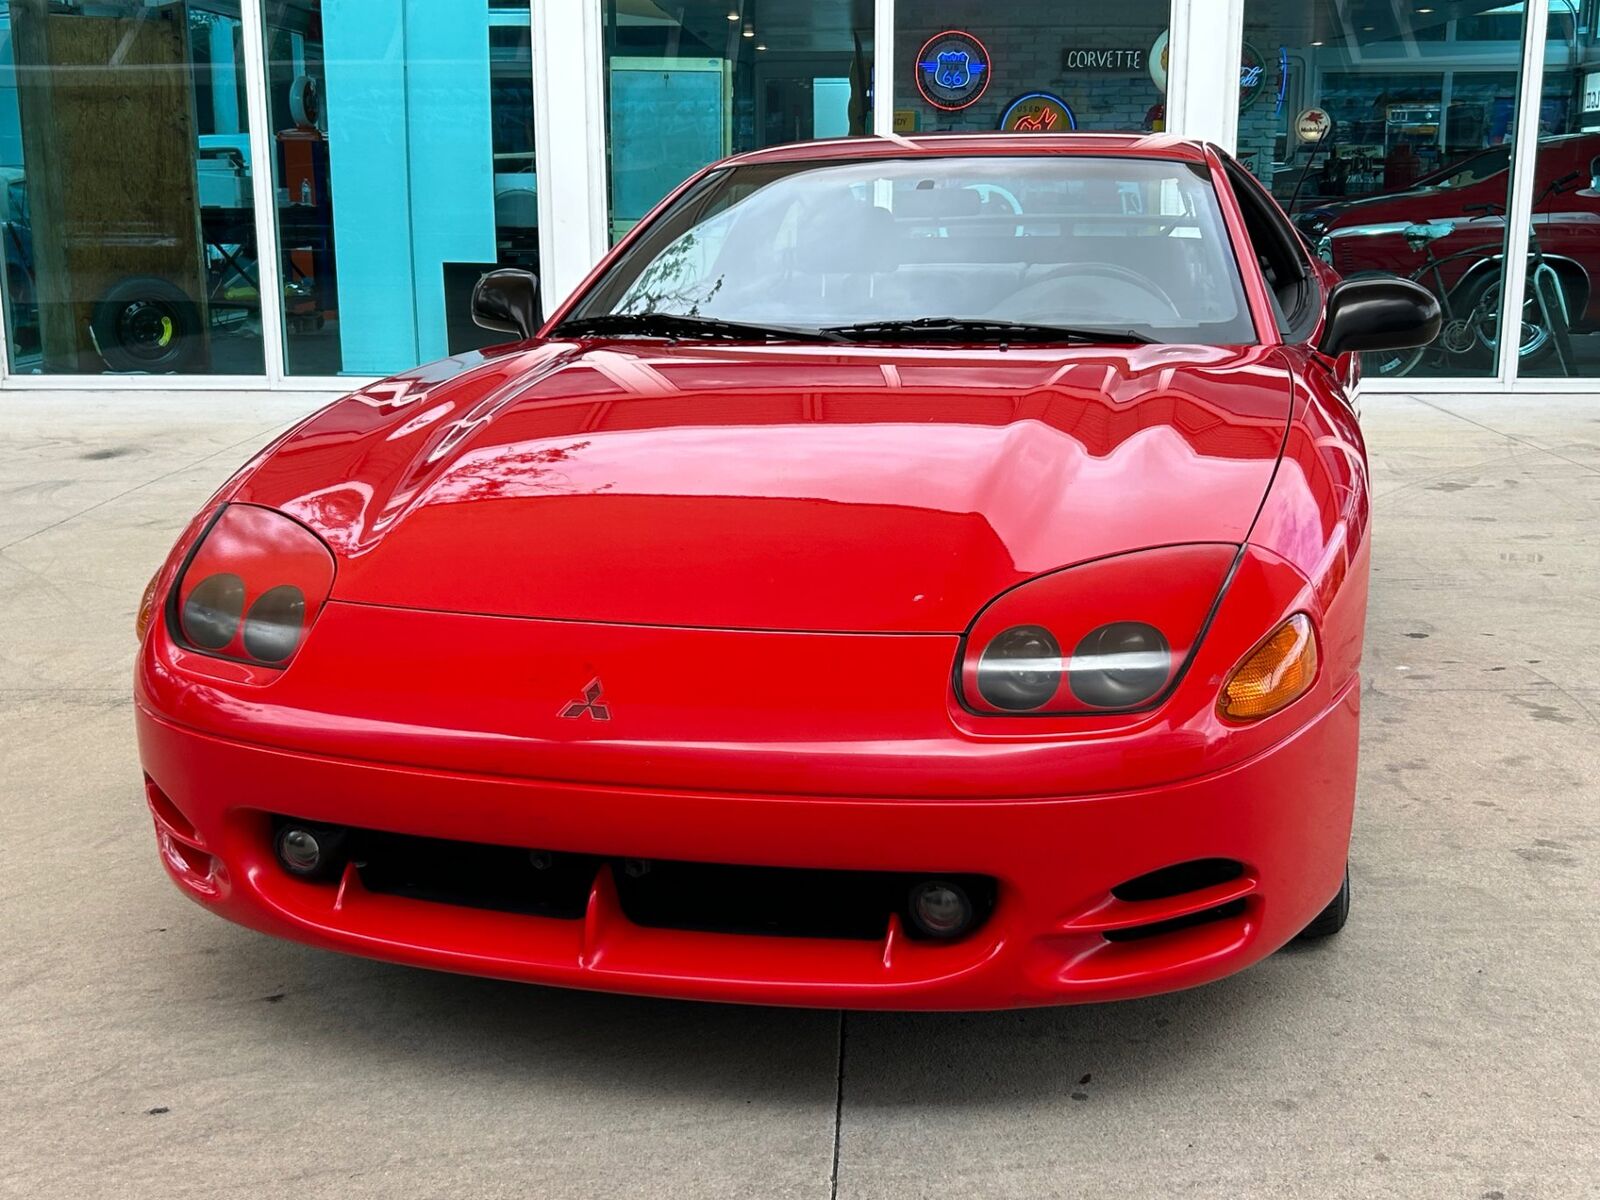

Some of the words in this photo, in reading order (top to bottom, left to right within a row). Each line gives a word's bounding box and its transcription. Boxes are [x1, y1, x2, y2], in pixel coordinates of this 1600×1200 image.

[1067, 50, 1141, 69] CORVETTE
[942, 70, 962, 85] 66
[1017, 104, 1041, 113] USED
